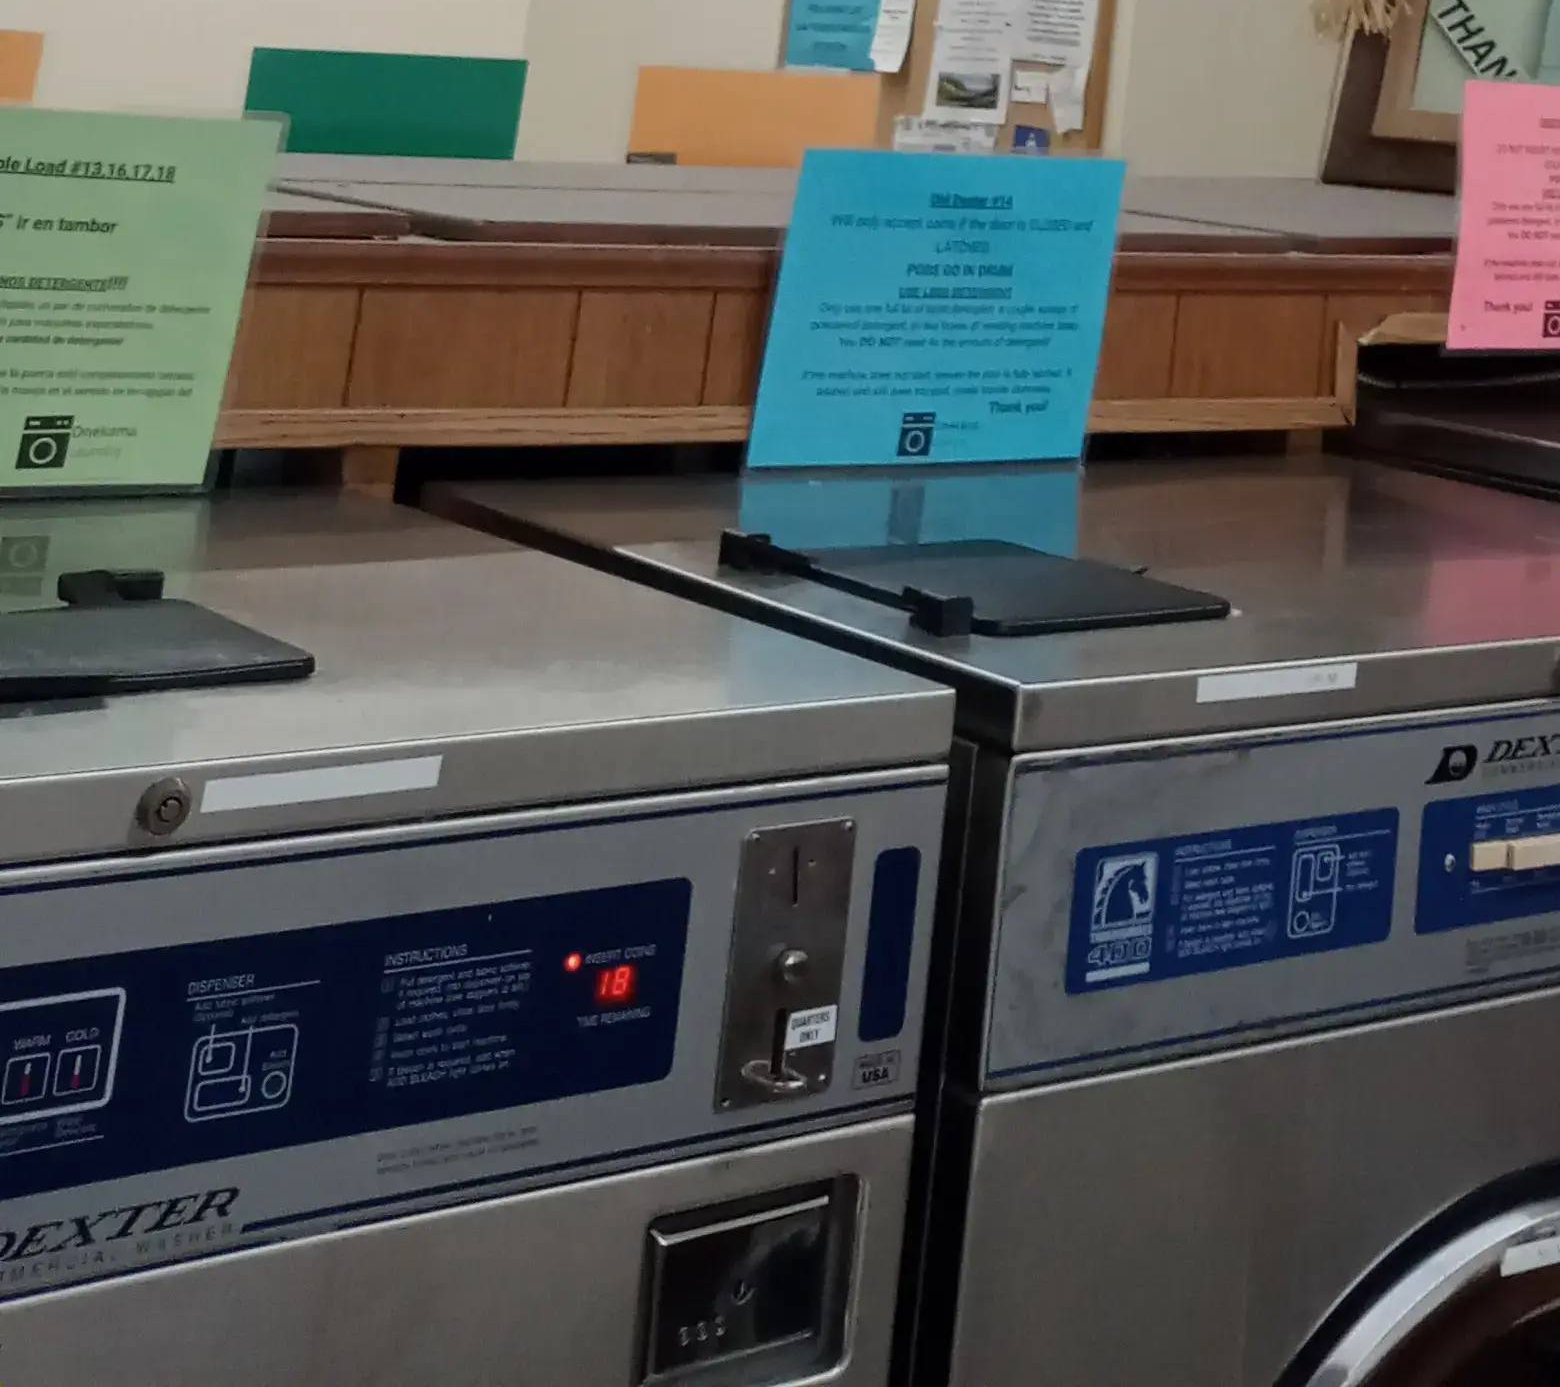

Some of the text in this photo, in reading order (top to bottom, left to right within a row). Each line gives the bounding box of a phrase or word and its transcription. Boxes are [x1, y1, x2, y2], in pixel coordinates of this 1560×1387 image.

[25, 157, 67, 177] Load
[32, 218, 54, 232] en
[58, 217, 118, 234] tambor
[384, 944, 468, 967] INSTRUCTIONS
[584, 948, 622, 965] INSERT
[188, 973, 256, 996] DISPENSER
[599, 965, 632, 997] 18
[13, 1034, 52, 1050] WARM
[65, 1026, 101, 1044] COLD
[862, 1067, 889, 1084] USA
[0, 1187, 241, 1263] EXTER
